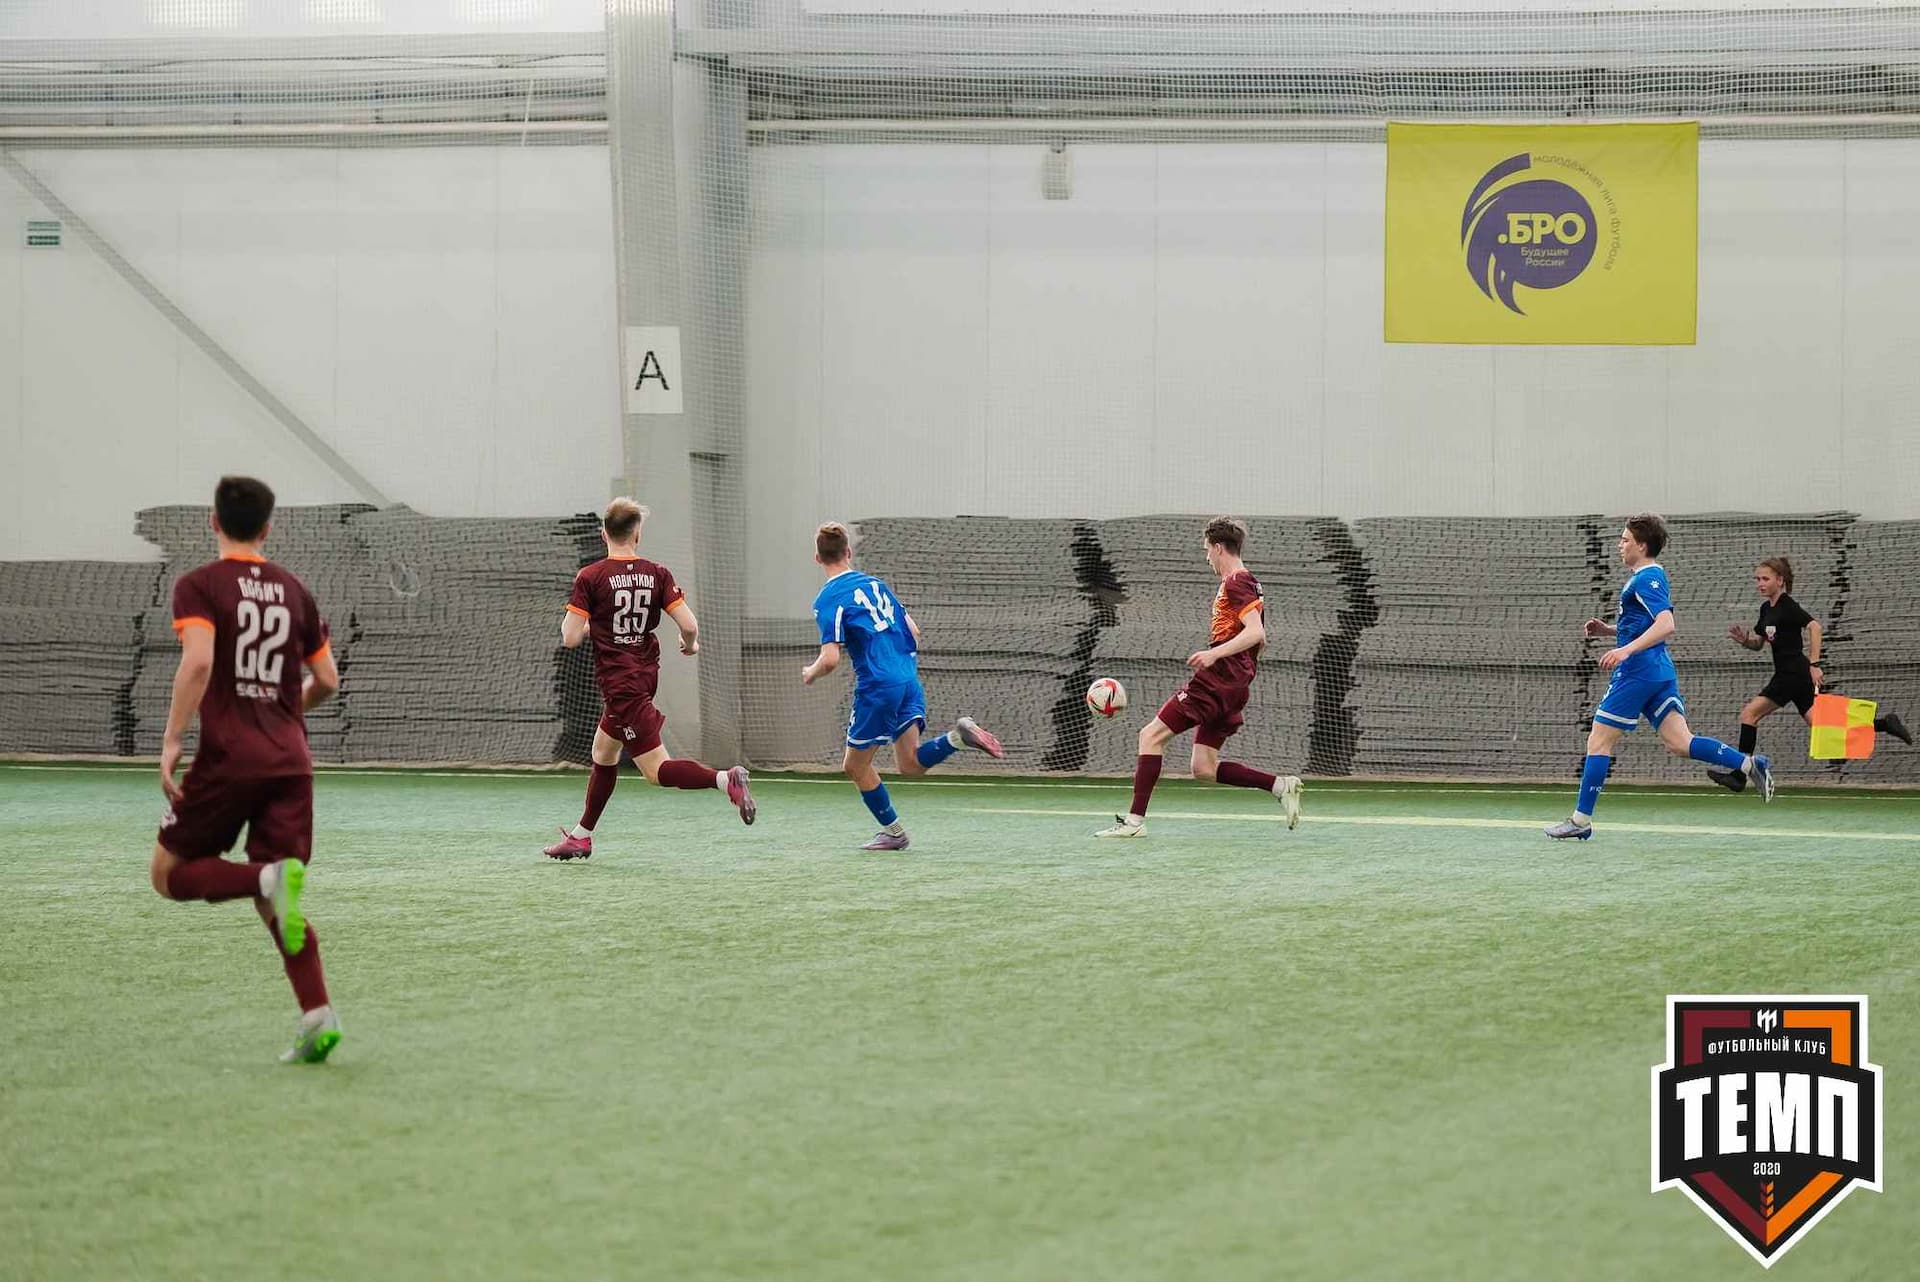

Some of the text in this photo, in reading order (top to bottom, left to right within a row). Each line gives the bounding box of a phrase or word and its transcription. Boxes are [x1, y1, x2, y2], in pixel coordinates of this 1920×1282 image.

[1497, 211, 1587, 245] .БРО
[1603, 217, 1622, 271] футбола
[1520, 246, 1569, 257] Будущее
[1525, 257, 1566, 267] России
[608, 573, 655, 590] НОВИЧКОВ
[612, 588, 652, 634] 25
[853, 580, 896, 632] 14
[235, 600, 291, 684] 22
[622, 726, 637, 741] 25
